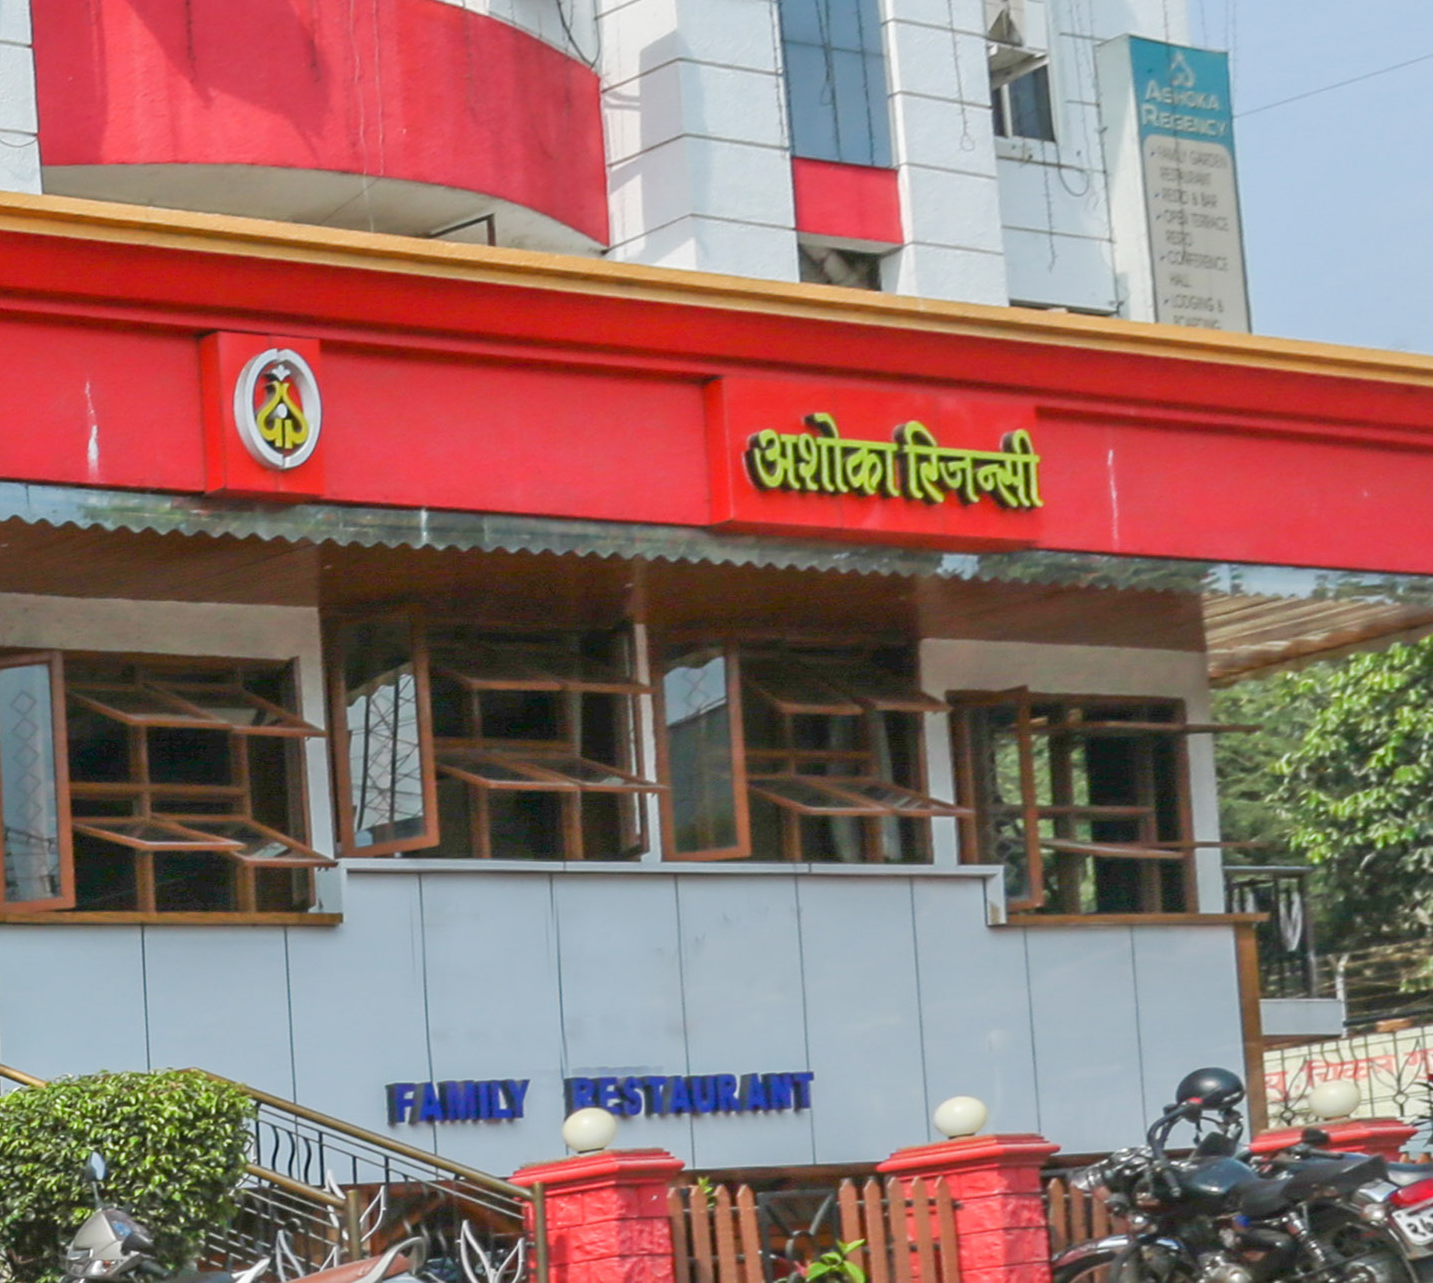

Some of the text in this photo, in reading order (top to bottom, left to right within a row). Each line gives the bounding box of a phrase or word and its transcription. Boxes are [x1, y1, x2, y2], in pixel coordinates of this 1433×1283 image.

[745, 411, 1044, 508] अशोका रिजन्सी
[386, 1071, 814, 1125] FAMILY RESTAURANT
